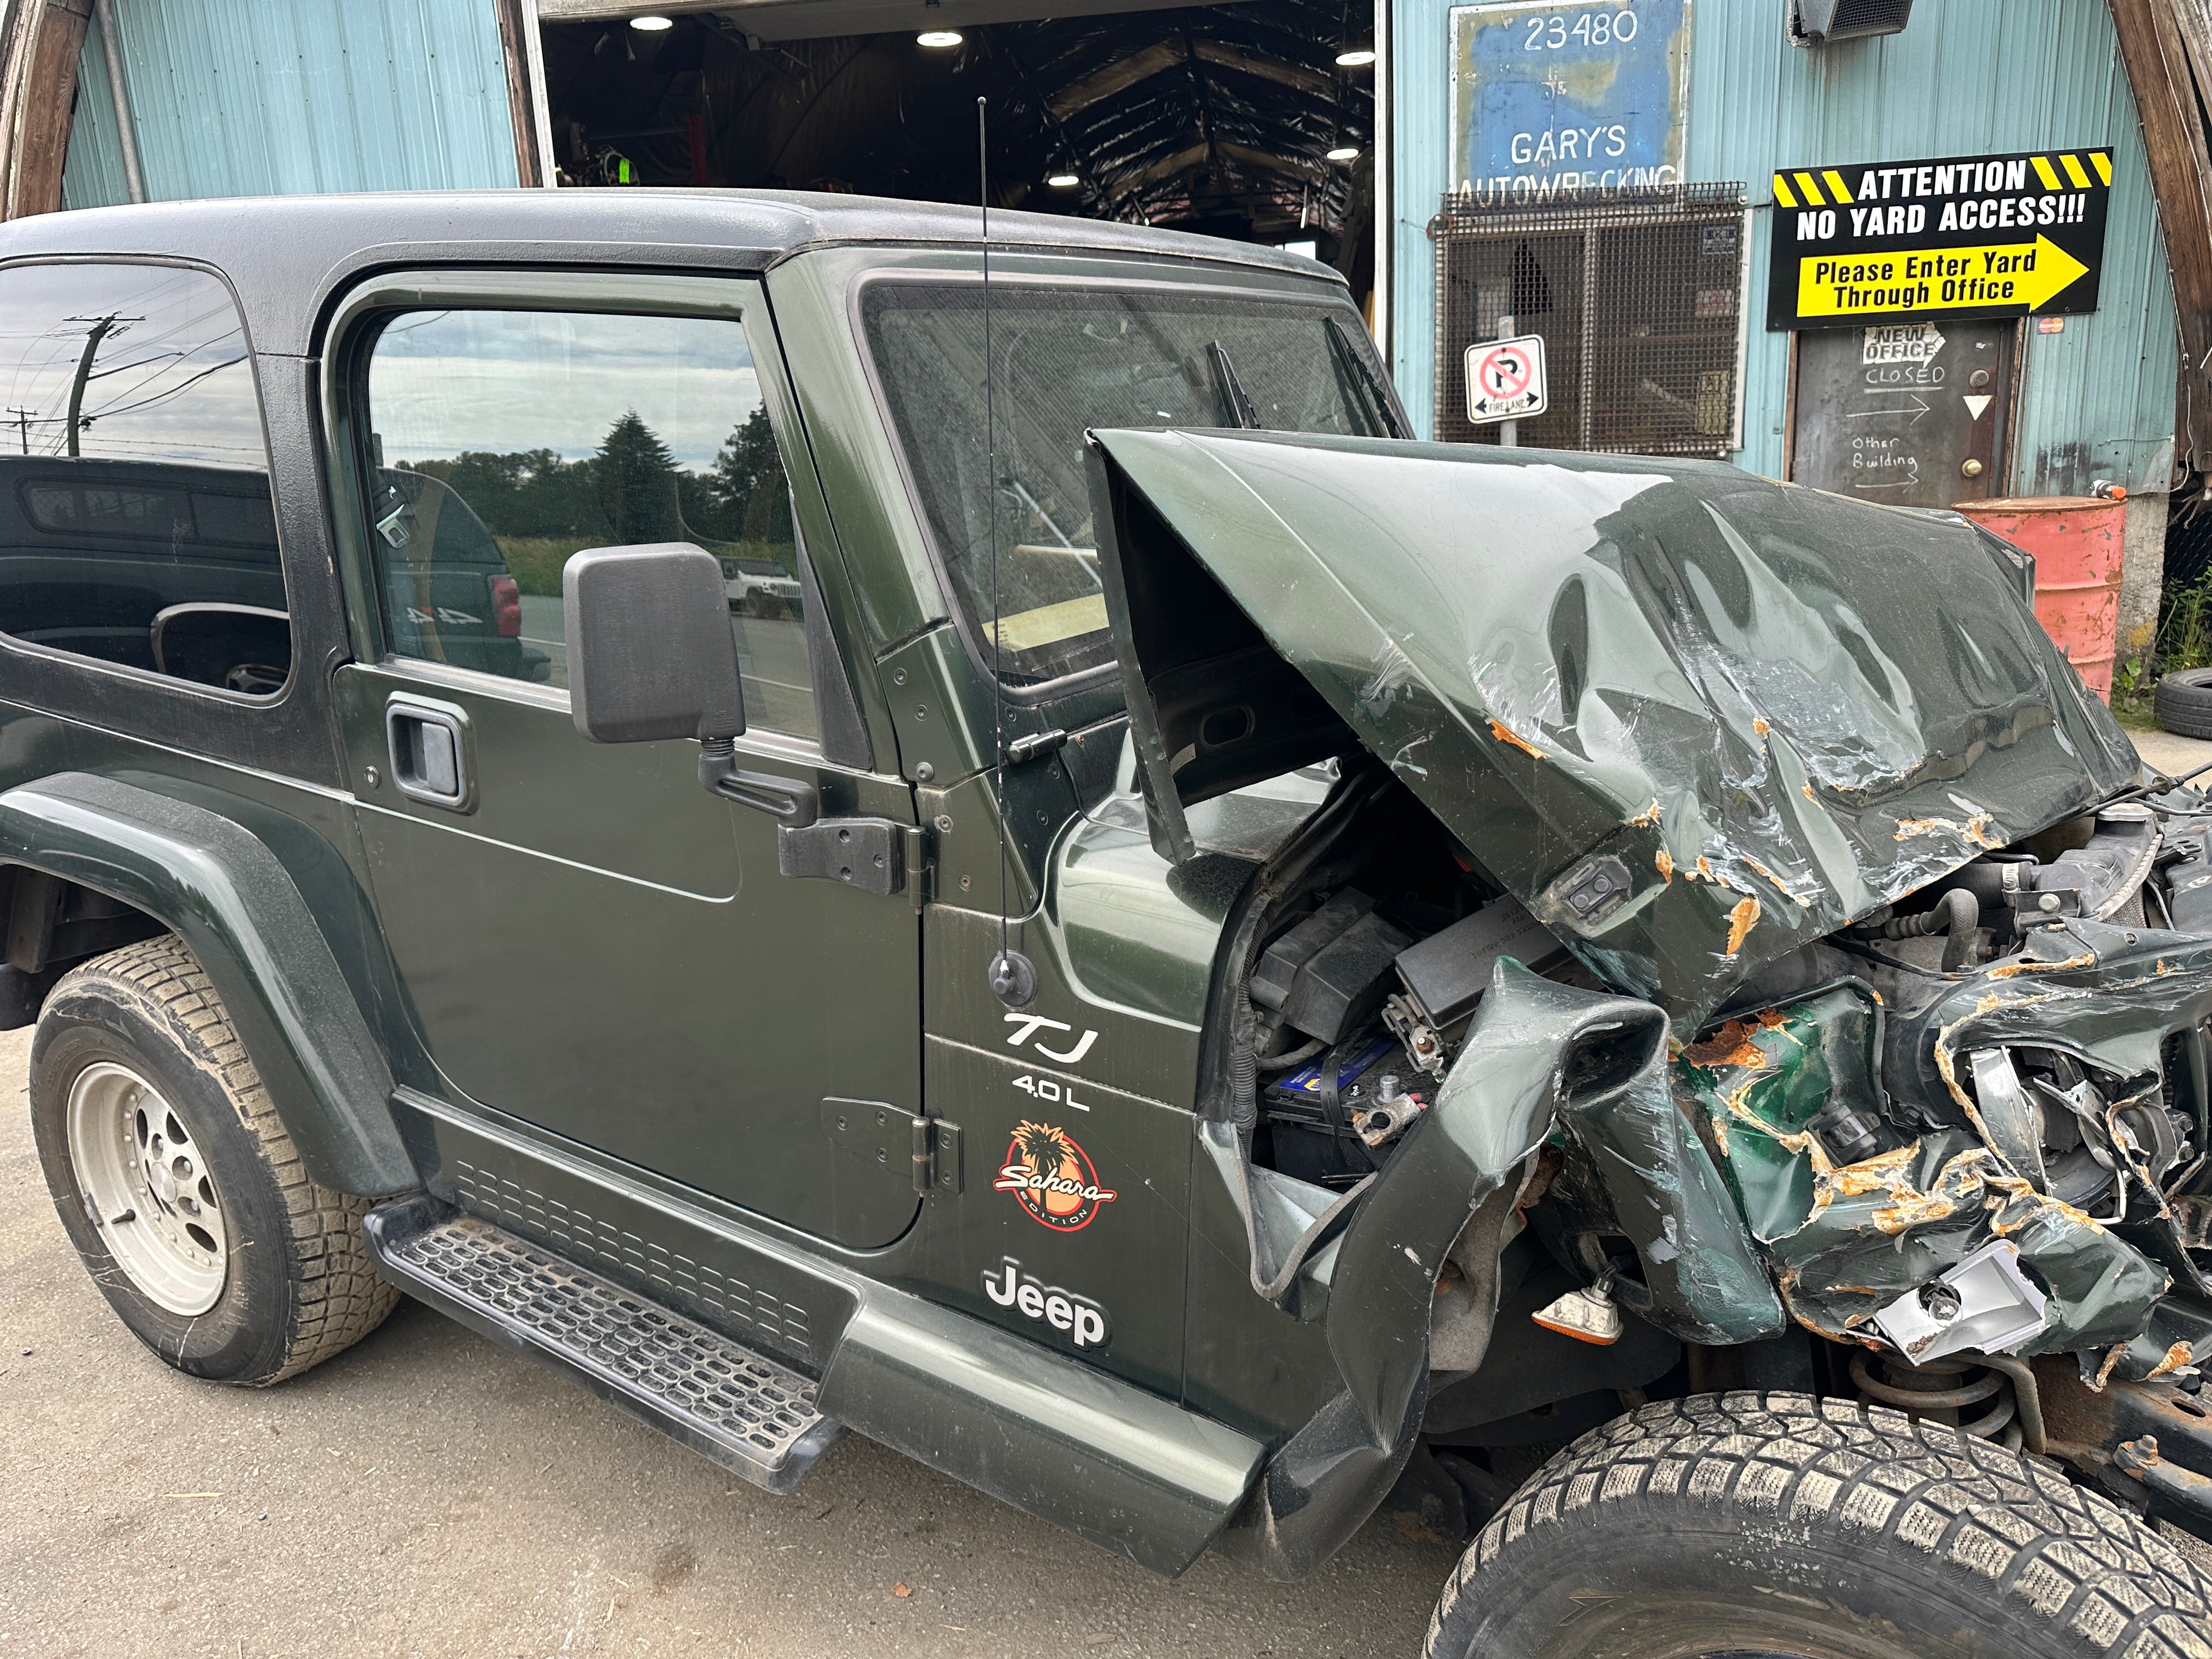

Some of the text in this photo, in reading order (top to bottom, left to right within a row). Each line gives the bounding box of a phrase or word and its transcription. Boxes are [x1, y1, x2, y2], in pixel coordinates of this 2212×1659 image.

[1524, 10, 1638, 51] 23480
[1511, 124, 1626, 164] GARY'S
[1858, 160, 2027, 200] ATTENTION
[1797, 194, 2086, 241] NO YARD ACCESS!!!
[1815, 249, 2037, 285] Please Enter Yard
[1834, 279, 2014, 308] Through Office
[1866, 343, 1935, 360] OFFICE
[1877, 327, 1925, 343] NEW
[1865, 366, 1945, 384] CLOSED
[1489, 402, 1505, 413] FIRE
[1853, 453, 1918, 475] Building
[1003, 1013, 1099, 1063] TJ
[995, 1165, 1116, 1202] Sahara
[1018, 1189, 1088, 1226] EDITION
[984, 1265, 1105, 1347] Jeep
